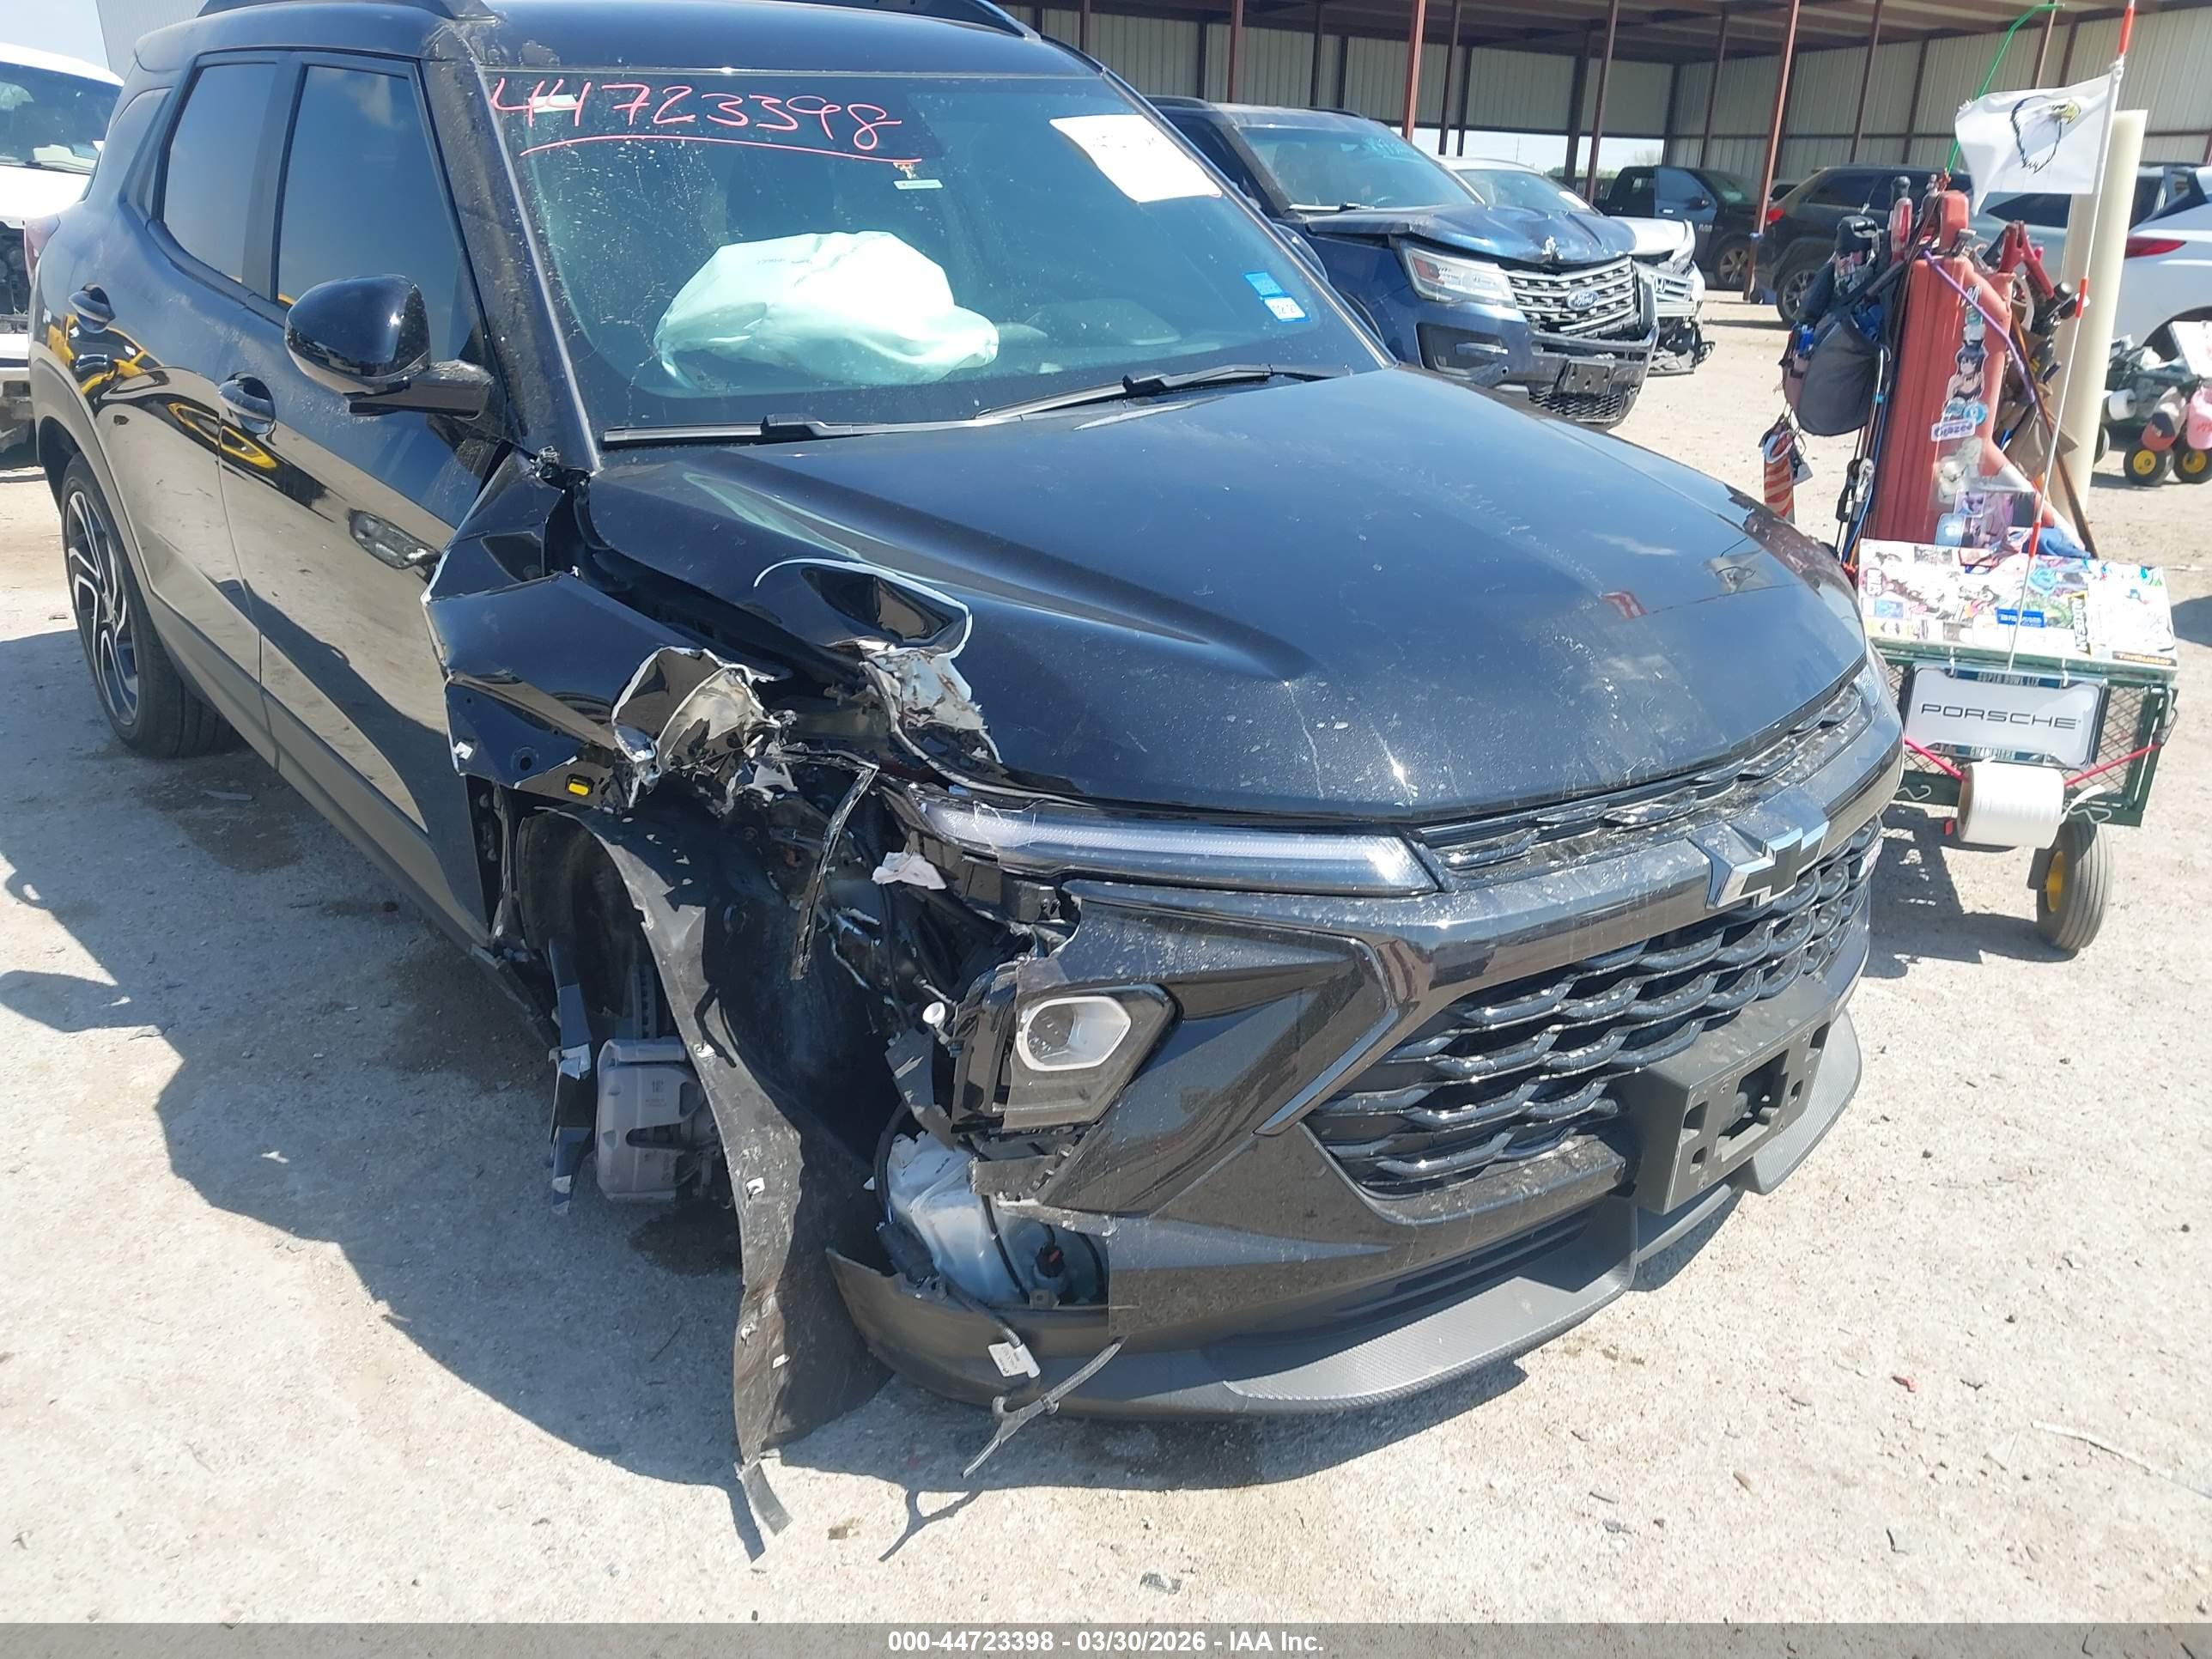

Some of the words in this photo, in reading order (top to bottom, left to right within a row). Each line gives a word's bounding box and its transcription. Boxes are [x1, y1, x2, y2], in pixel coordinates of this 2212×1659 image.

[490, 76, 902, 151] 44723398
[1572, 292, 1595, 307] Ford
[1921, 702, 2077, 730] PORSCHE
